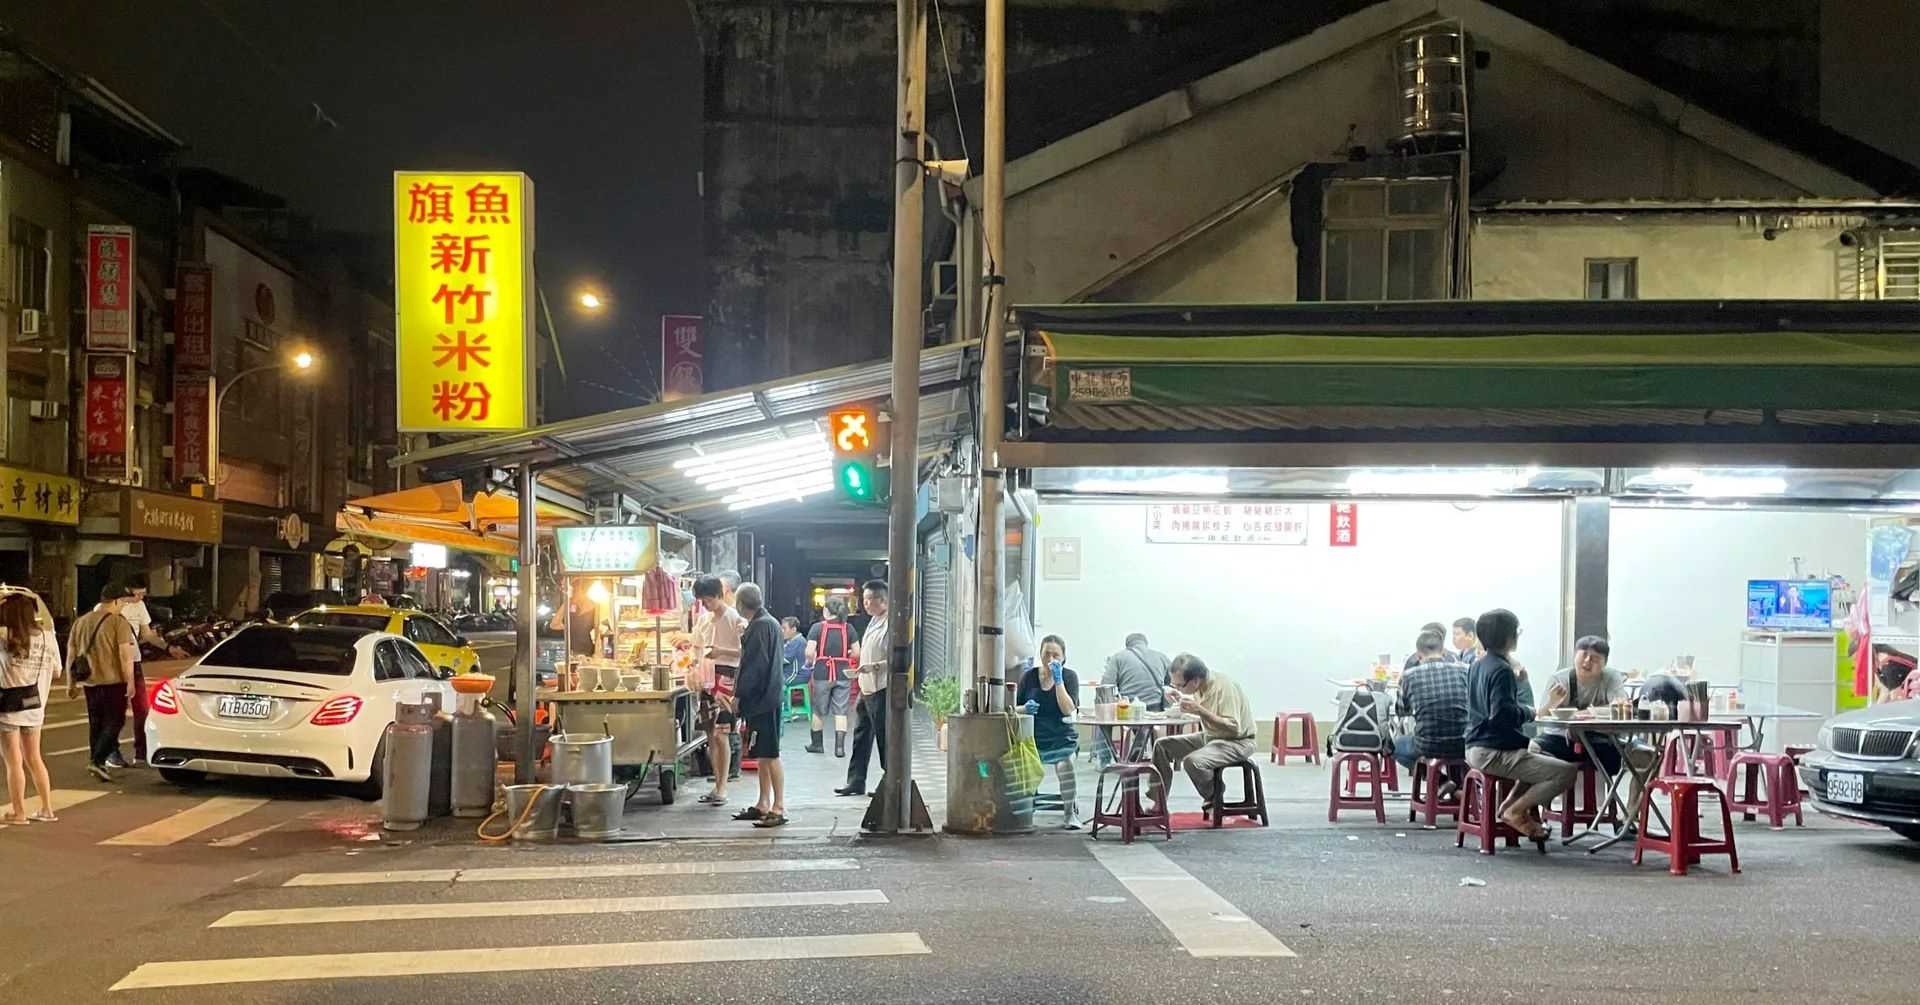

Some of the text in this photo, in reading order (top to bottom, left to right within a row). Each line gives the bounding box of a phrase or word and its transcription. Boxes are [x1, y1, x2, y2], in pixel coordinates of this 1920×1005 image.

[408, 182, 511, 225] 旗魚
[431, 233, 491, 422] 新竹米粉
[0, 477, 72, 515] 車材料
